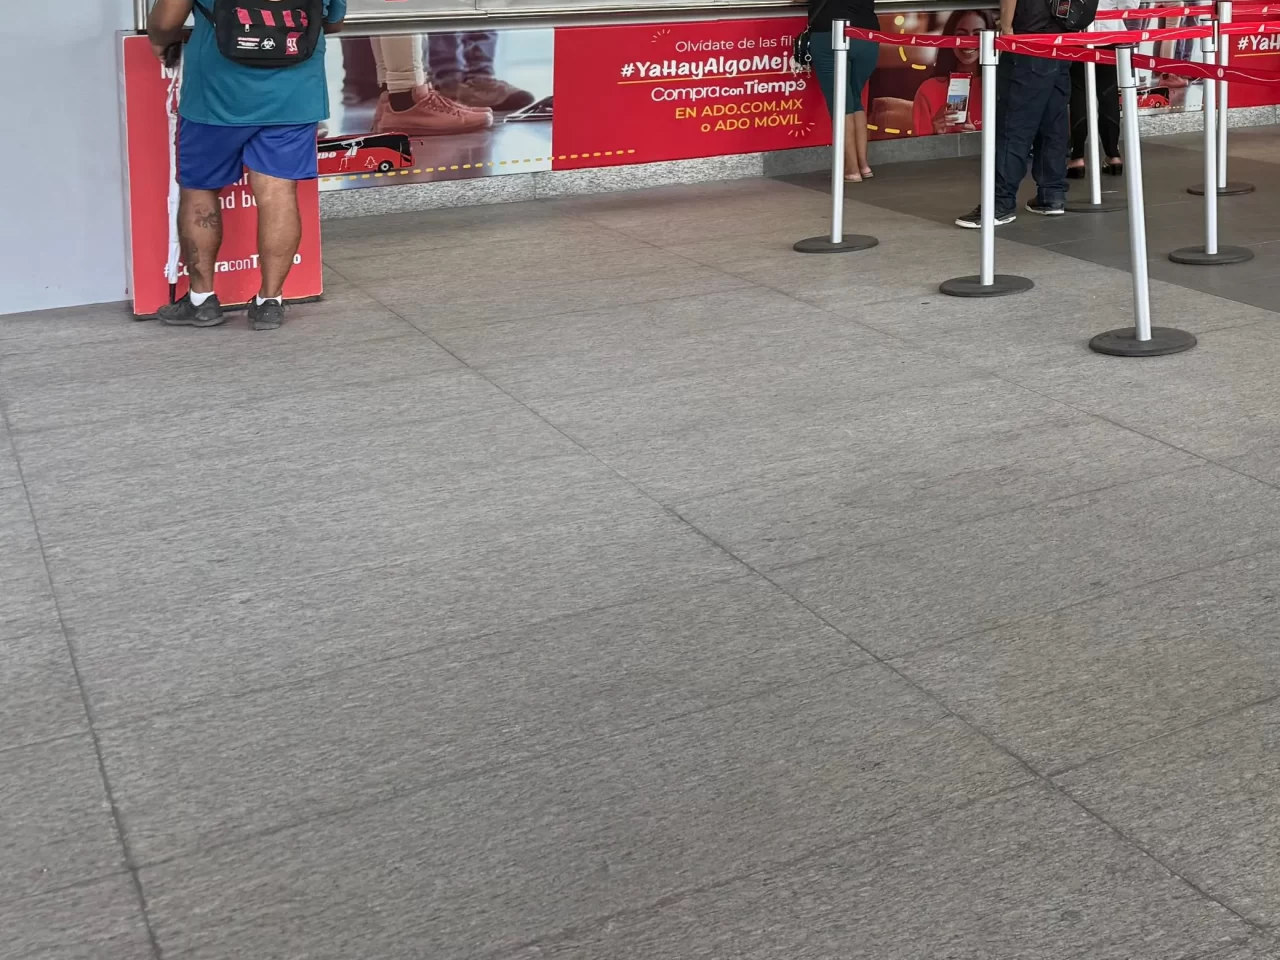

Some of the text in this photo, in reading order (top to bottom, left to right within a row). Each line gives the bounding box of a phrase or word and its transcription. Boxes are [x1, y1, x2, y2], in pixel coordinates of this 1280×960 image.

[675, 36, 777, 52] Olvídate de las
[620, 51, 797, 80] #YaHayAlgoMej
[675, 99, 803, 119] EN ADO.COM.MX
[714, 118, 750, 131] ADO
[754, 113, 802, 128] MÓVIL
